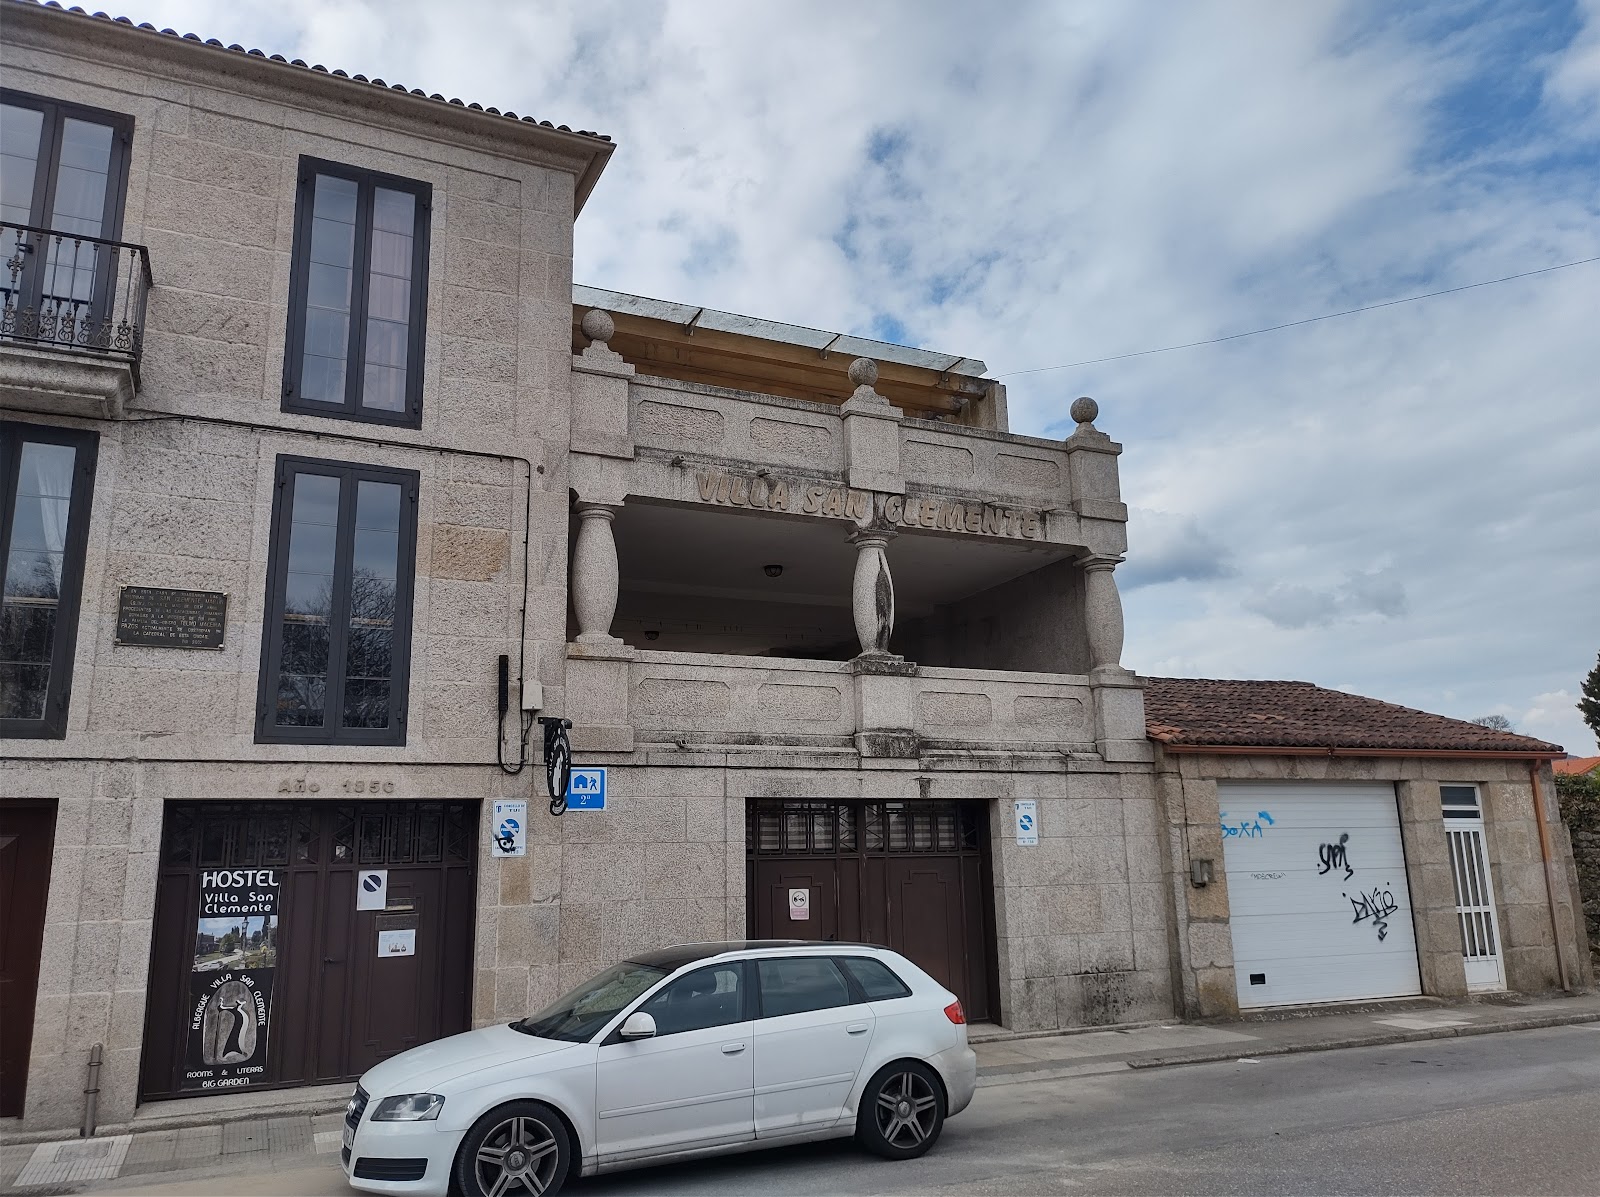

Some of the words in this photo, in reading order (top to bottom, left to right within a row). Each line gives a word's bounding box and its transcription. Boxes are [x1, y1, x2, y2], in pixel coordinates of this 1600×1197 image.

[696, 471, 789, 510] VILLA
[803, 486, 865, 519] SAN
[884, 495, 1037, 538] CLEMENTE
[278, 779, 320, 793] Año
[202, 870, 279, 888] HOSTEL
[205, 892, 239, 903] Villa
[248, 891, 274, 902] San
[204, 903, 272, 914] Clemente
[192, 993, 210, 1030] ALBERGUE
[210, 973, 232, 989] VILLA
[240, 974, 255, 988] SAN
[253, 990, 266, 1027] CLEMENTE
[186, 1070, 214, 1079] ROOMS
[236, 1065, 264, 1074] LITERAS
[202, 1080, 216, 1088] BIG
[217, 1077, 250, 1087] GARDEN
